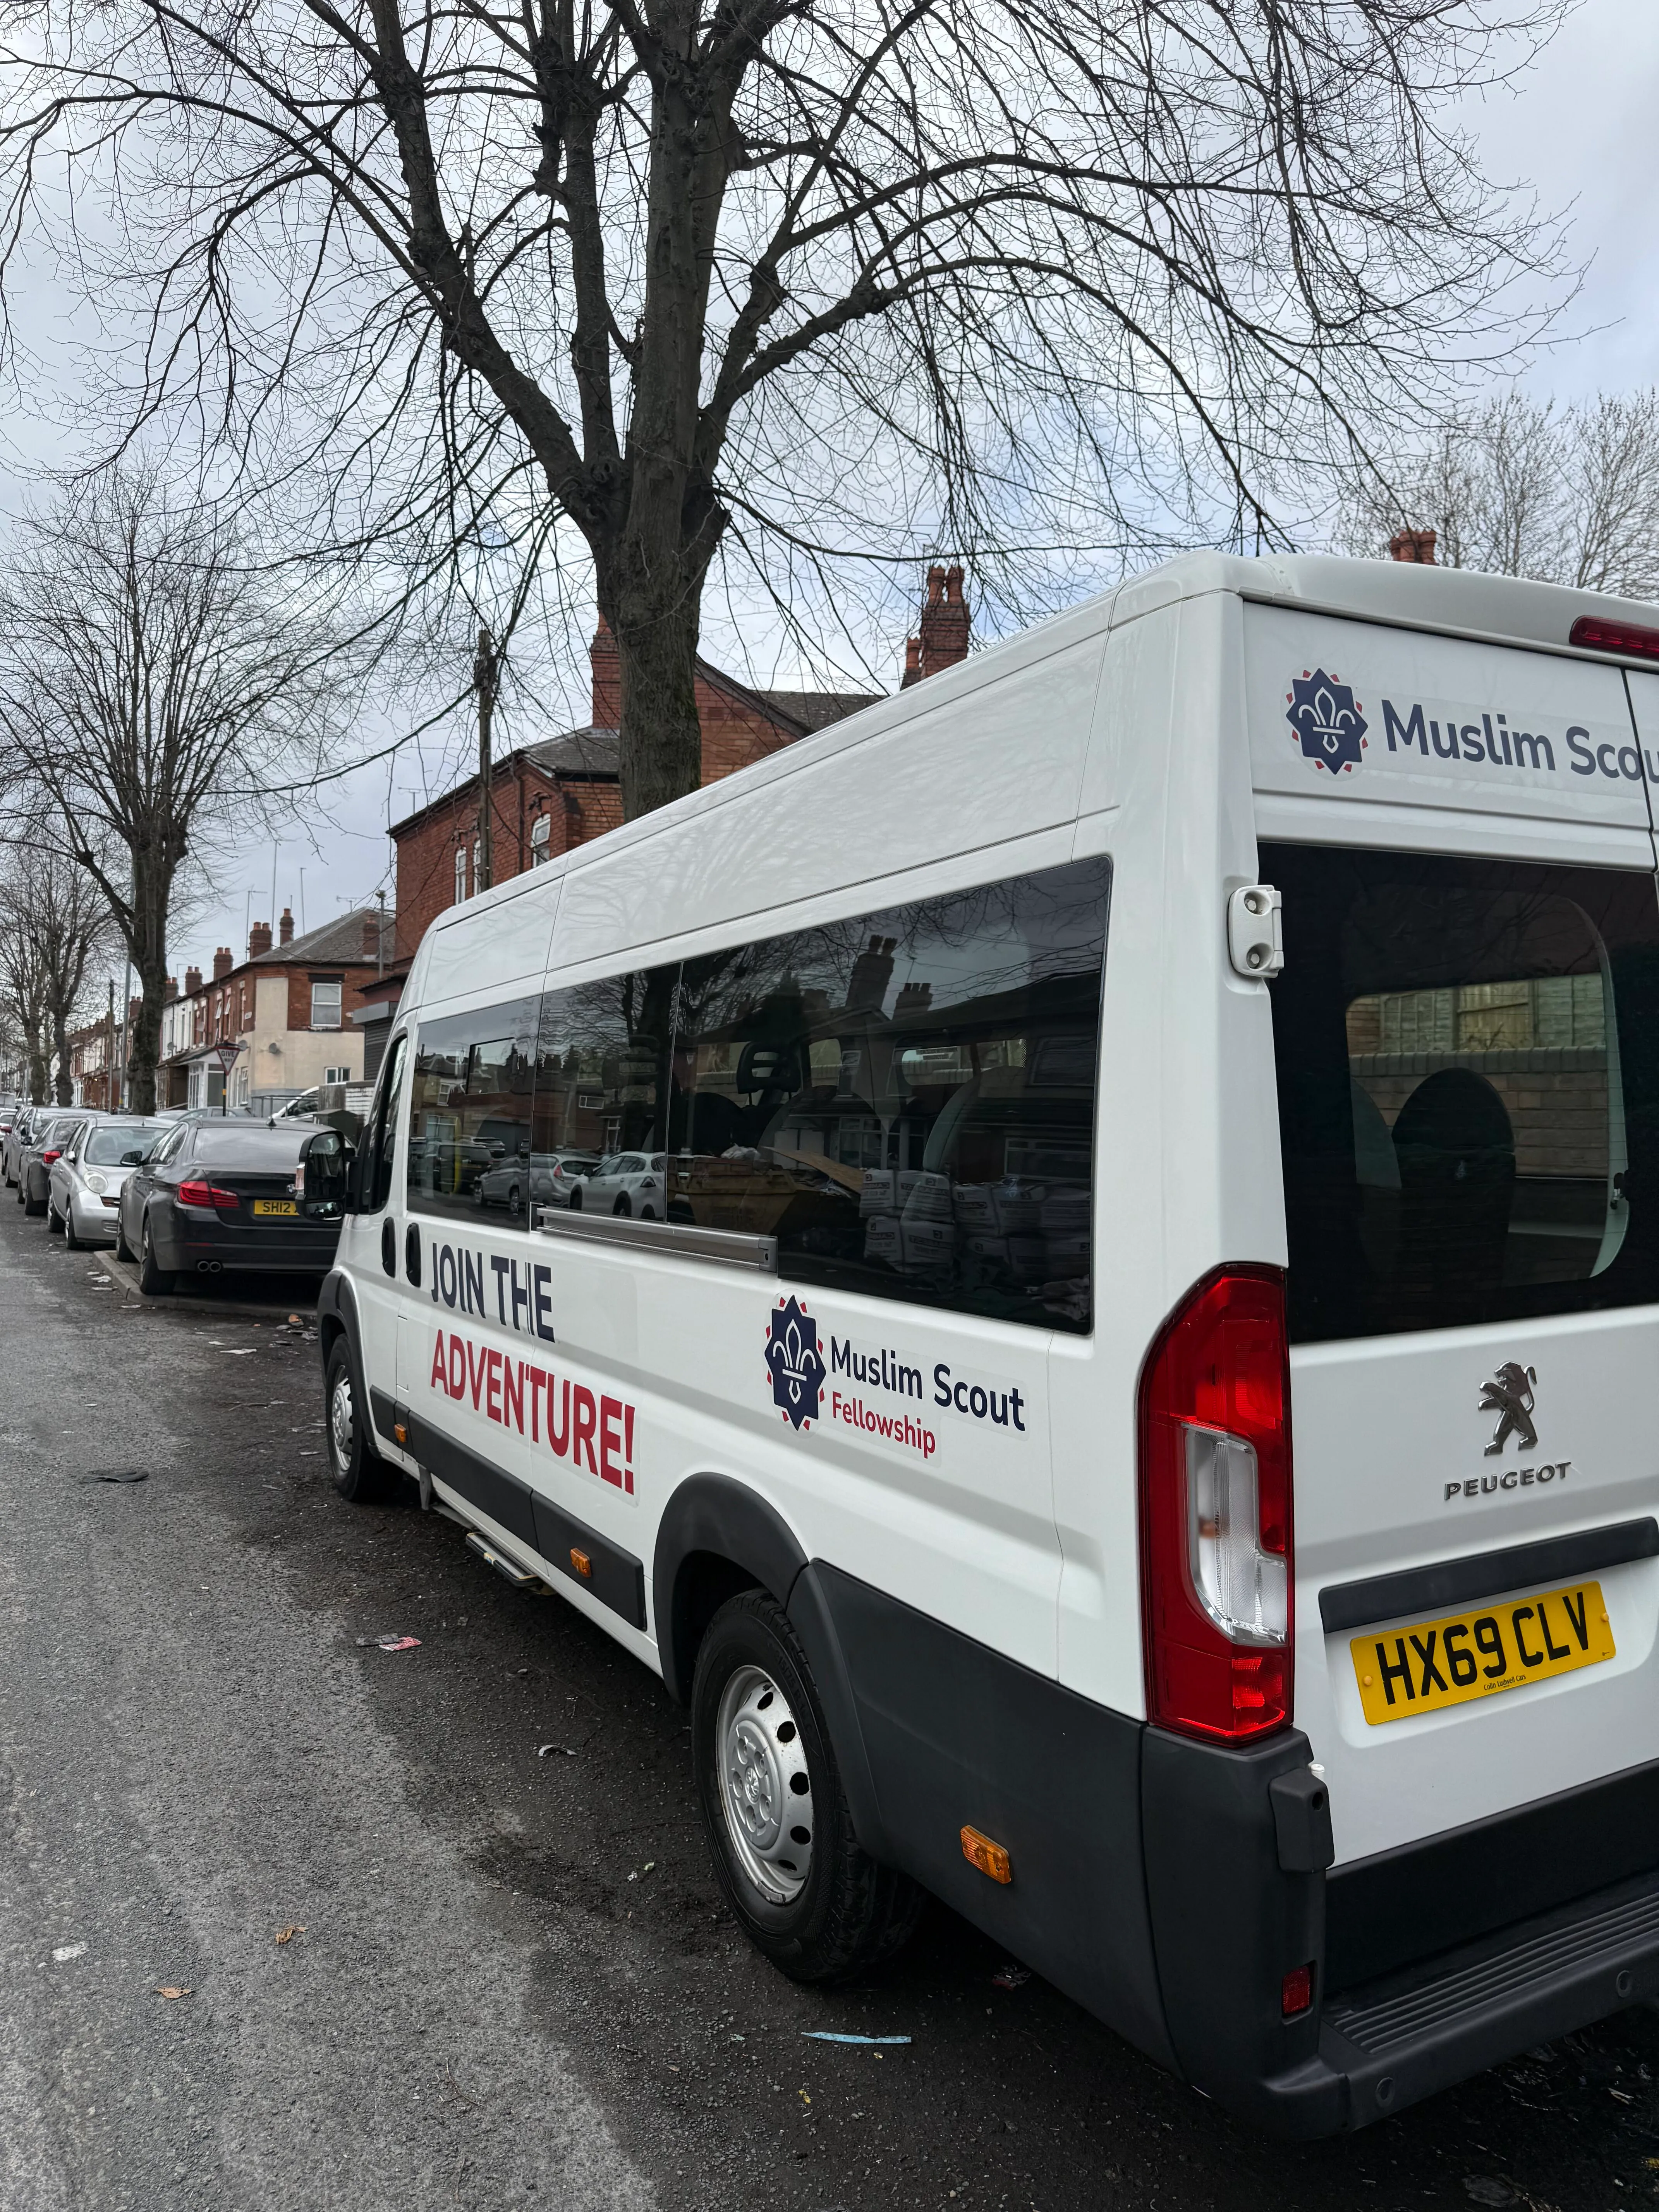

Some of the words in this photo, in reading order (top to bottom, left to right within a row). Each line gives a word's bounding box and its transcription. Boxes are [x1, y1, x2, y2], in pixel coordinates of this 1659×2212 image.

[1381, 699, 1556, 771] Muslim
[263, 1202, 290, 1213] SH12
[431, 1242, 486, 1319] JOIN
[491, 1254, 555, 1343] THE
[431, 1329, 635, 1496] ADVENTURE!
[831, 1335, 922, 1400] Muslim
[934, 1364, 1026, 1432] Scout
[832, 1391, 936, 1459] Fellowship
[1444, 1461, 1571, 1500] PEUGEOT
[1375, 1616, 1508, 1705] HX69
[1511, 1591, 1589, 1669] CLV
[1484, 1682, 1496, 1690] Colin
